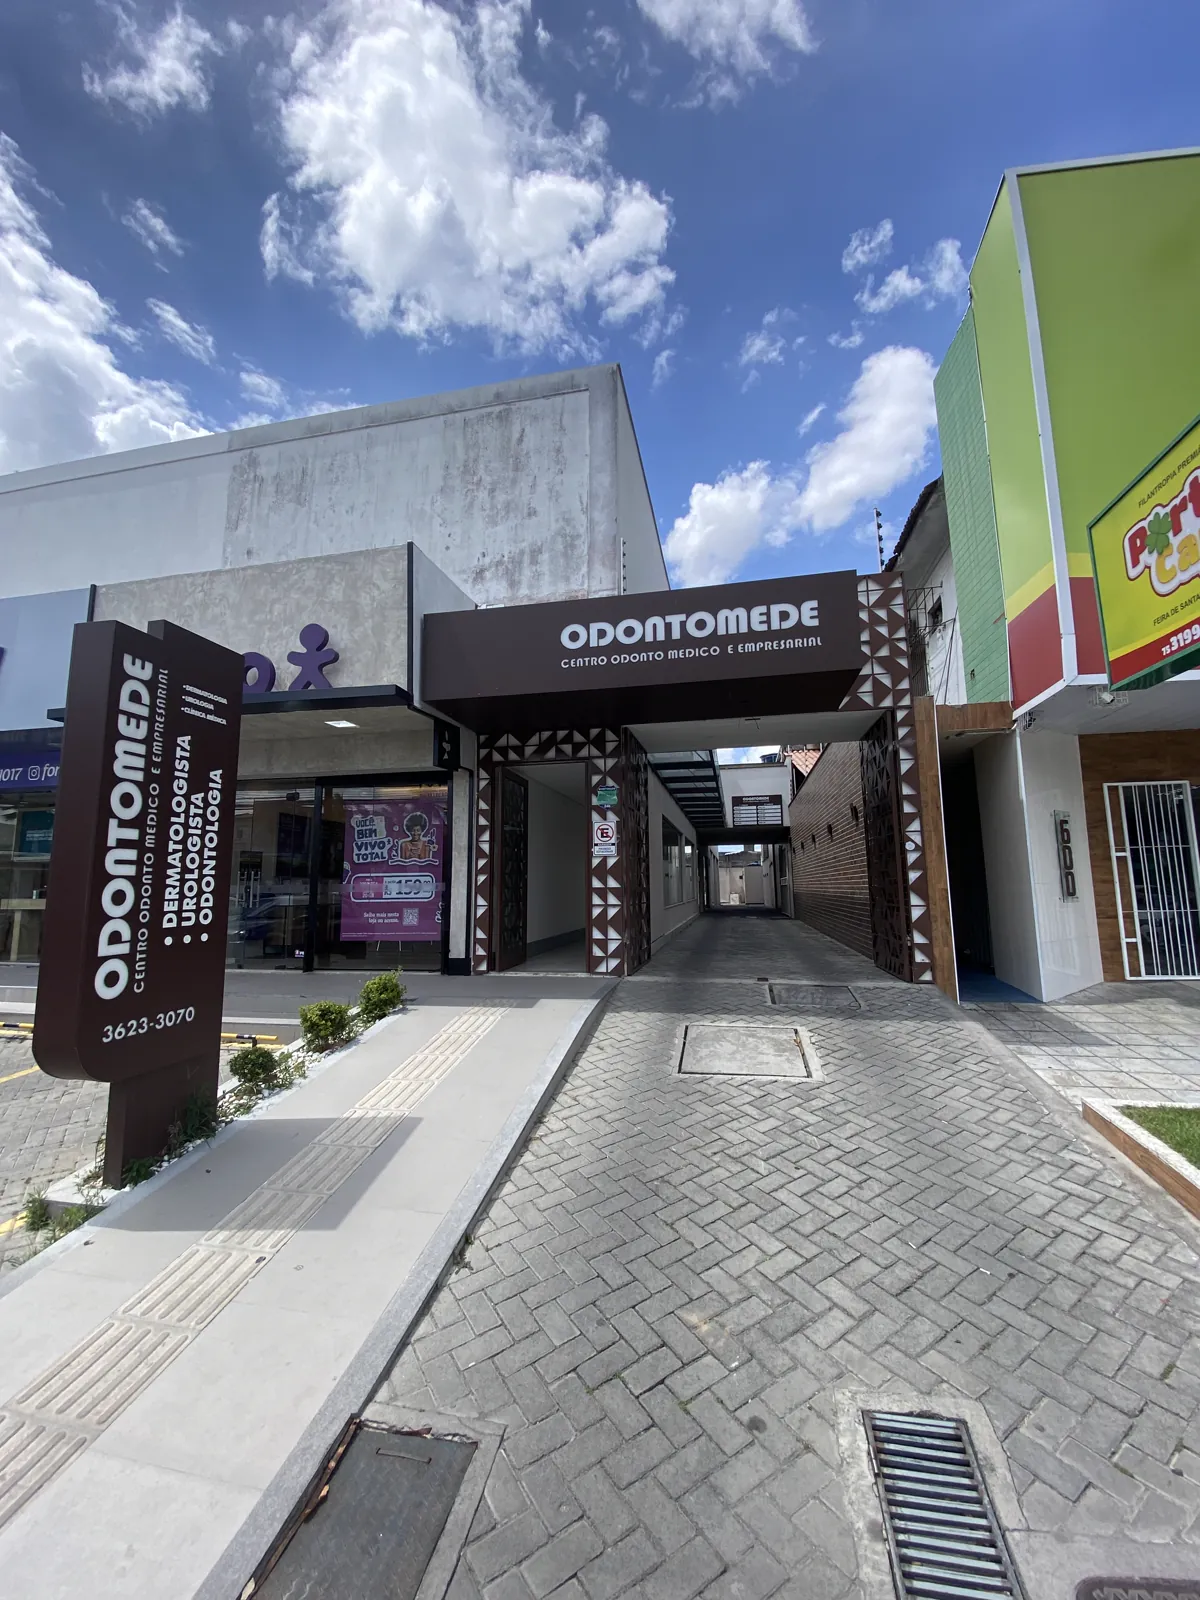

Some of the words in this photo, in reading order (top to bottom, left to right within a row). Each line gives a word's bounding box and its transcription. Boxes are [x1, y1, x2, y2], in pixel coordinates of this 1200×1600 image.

[1138, 470, 1178, 508] FILANTROPIA
[560, 600, 820, 650] ODONTOMEDE
[1153, 612, 1170, 627] FEIRA
[1170, 606, 1180, 616] DE
[560, 656, 608, 668] CENTRO
[610, 650, 664, 664] ODONTO
[668, 645, 720, 659] MEDICO
[727, 644, 735, 654] E
[738, 636, 823, 653] EMPRESARIAL
[152, 668, 169, 763] EMPRESARIAL
[151, 766, 161, 774] E
[94, 652, 153, 1000] ODONTOMEDE
[145, 783, 161, 848] MEDICO
[163, 735, 192, 929] DERMATOLOGISTA
[356, 828, 378, 840] BEM
[182, 792, 205, 927] UROLOGISTA
[200, 769, 223, 925] ODONTOLOGIA
[355, 840, 386, 852] VIVO
[355, 851, 387, 862] TOTAL
[139, 852, 154, 924] ODONTO
[133, 928, 149, 993] CENTRO
[102, 1006, 195, 1043] 3623-3070
